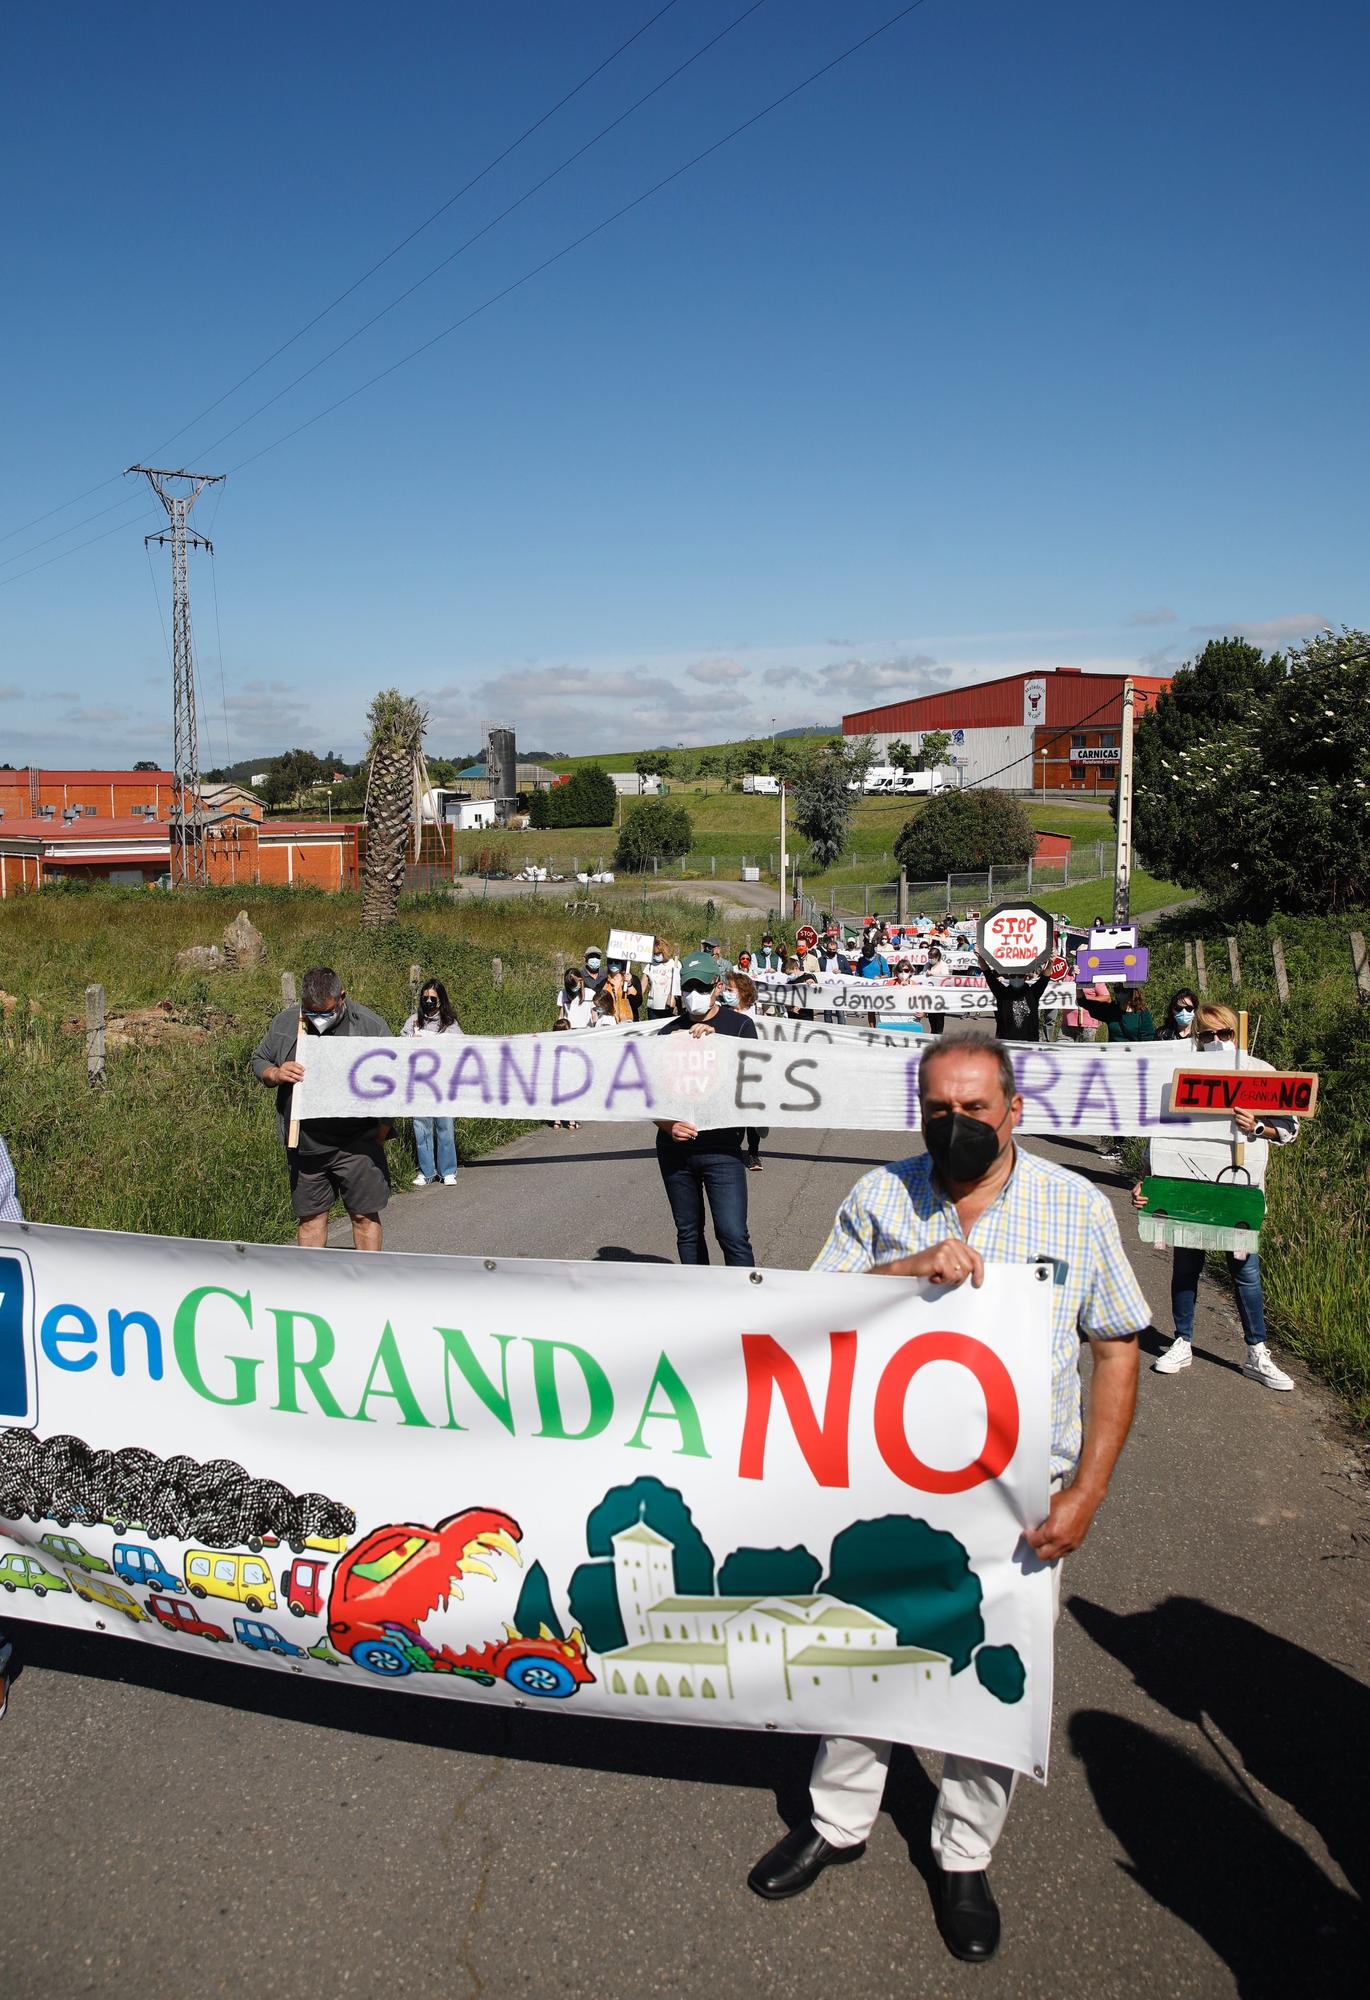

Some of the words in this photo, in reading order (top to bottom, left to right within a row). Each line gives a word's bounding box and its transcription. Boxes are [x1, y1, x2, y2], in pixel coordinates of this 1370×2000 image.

[1077, 749, 1119, 759] CARNICAS
[800, 929, 815, 937] STOP
[992, 916, 1037, 934] STOP
[1001, 933, 1034, 946] ITV
[993, 946, 1039, 960] GRANDA
[1051, 961, 1066, 974] TOP
[832, 986, 896, 1011] danos
[908, 994, 950, 1011] una
[348, 1041, 656, 1109] GRANDA
[734, 1049, 822, 1112] ES
[1180, 1078, 1242, 1108] ITV
[1277, 1080, 1312, 1109] NO
[738, 1330, 1020, 1495] NO
